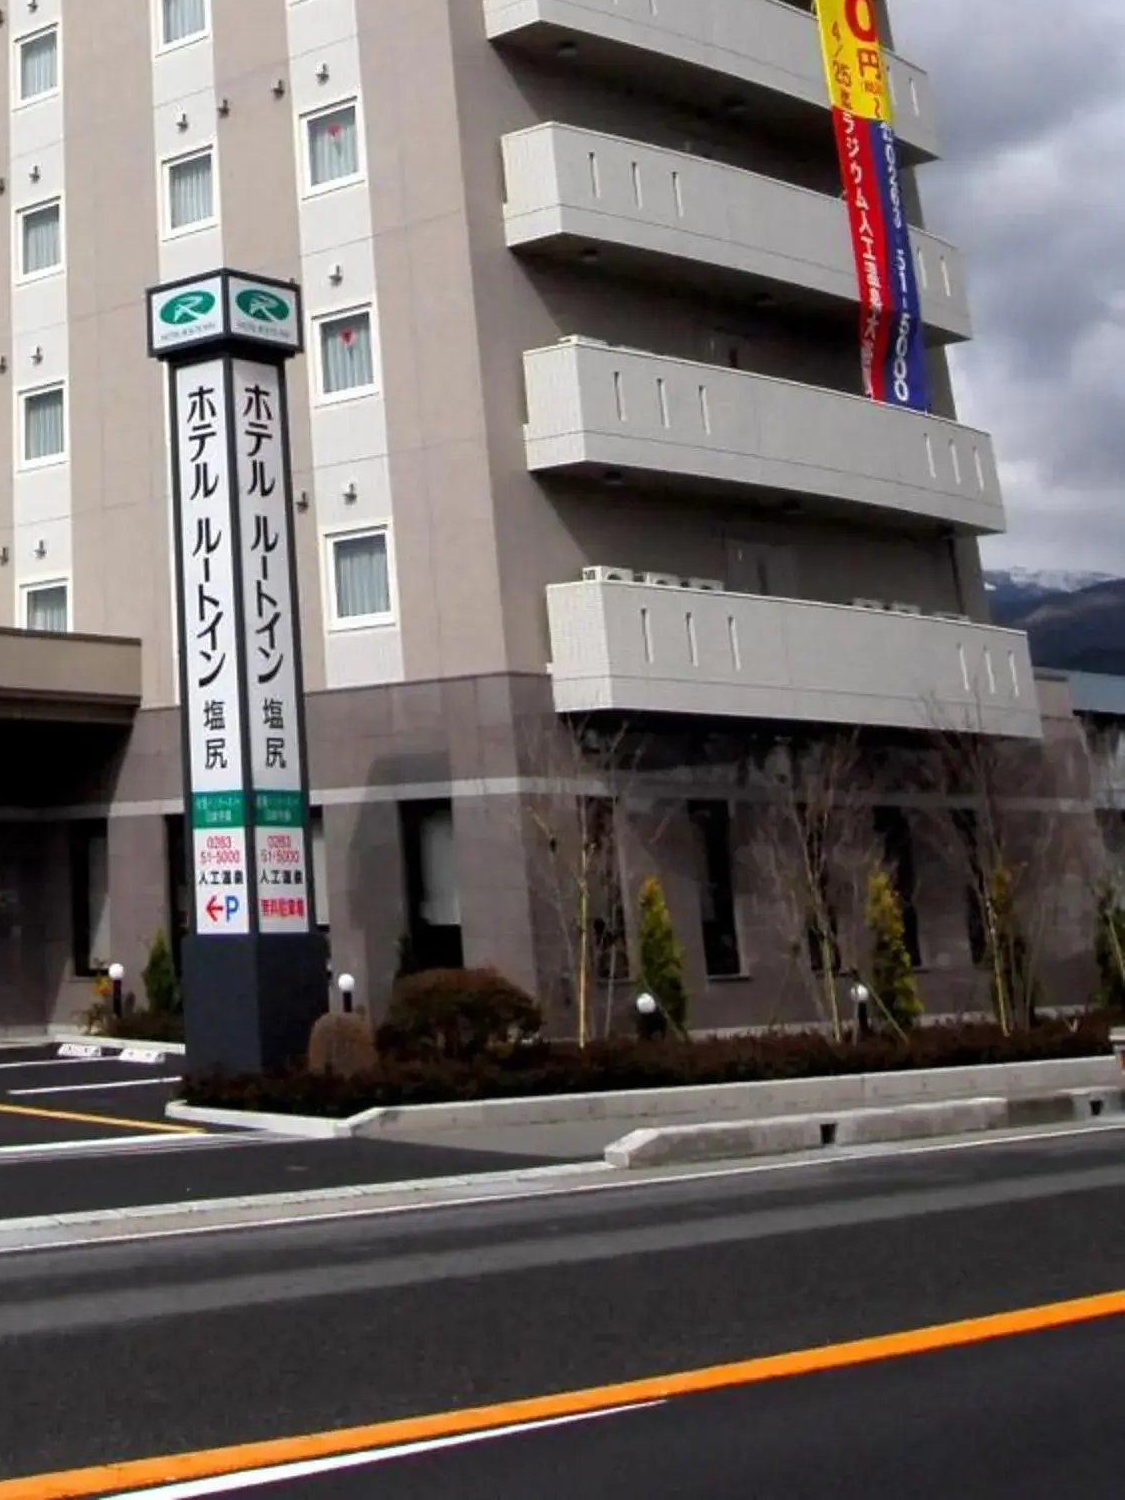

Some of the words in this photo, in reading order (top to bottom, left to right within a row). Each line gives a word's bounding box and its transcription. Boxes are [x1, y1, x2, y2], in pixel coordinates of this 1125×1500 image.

[187, 385, 219, 501] ホテル
[243, 384, 275, 498] ホテル
[192, 517, 226, 688] ルートイン
[251, 515, 284, 685] ルートイン
[203, 699, 228, 770] 塩尻
[263, 698, 287, 769] 塩尻
